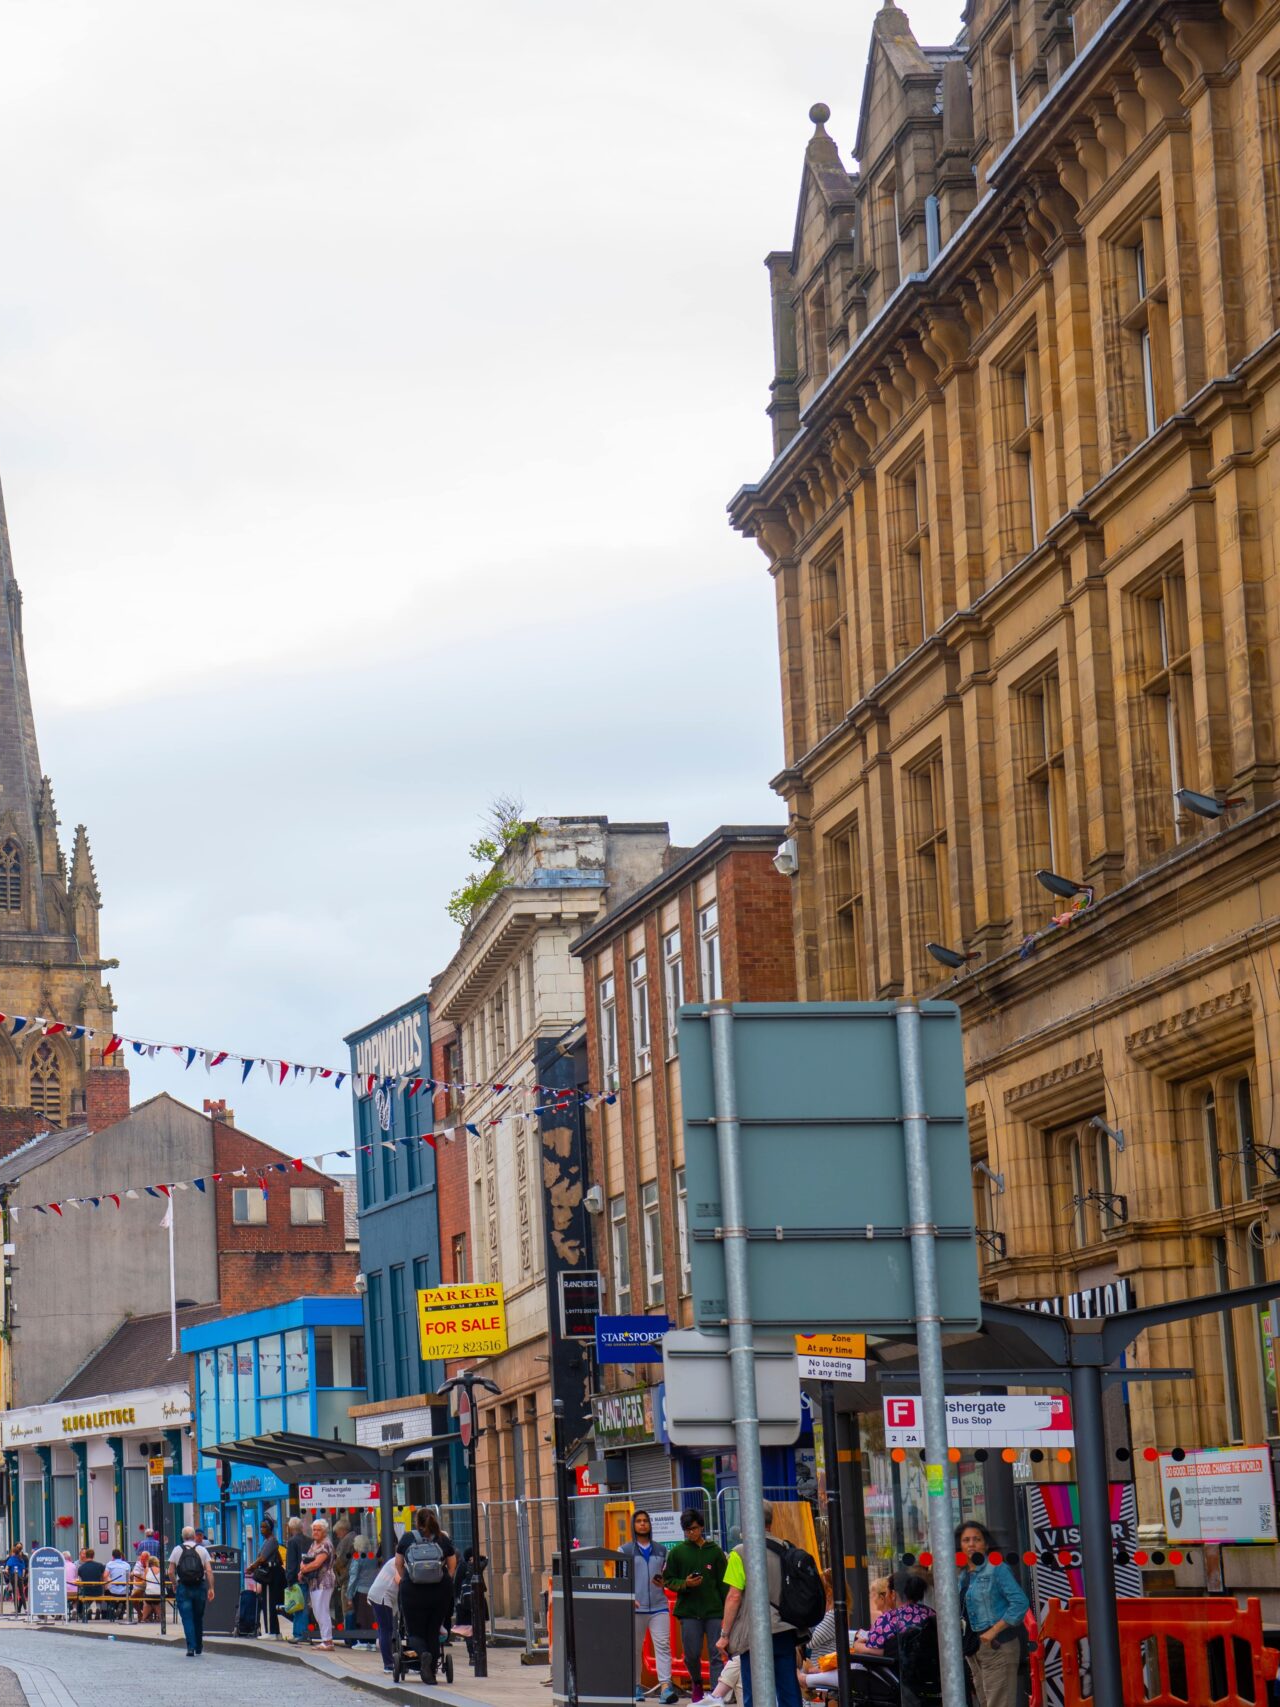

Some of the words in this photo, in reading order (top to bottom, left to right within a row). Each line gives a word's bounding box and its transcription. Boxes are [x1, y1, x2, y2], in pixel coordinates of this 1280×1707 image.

[356, 1011, 422, 1095] HOPWOODS
[424, 1288, 496, 1303] PARKER
[442, 1301, 496, 1310] COMPANY
[426, 1321, 456, 1335] FOR
[462, 1317, 500, 1332] SALE
[428, 1344, 459, 1356] 01772
[463, 1340, 501, 1353] 823516
[819, 1346, 832, 1354] any
[823, 1360, 851, 1370] loading
[598, 1394, 643, 1432] RANCHERS
[893, 1402, 908, 1423] F
[945, 1401, 1006, 1417] ishergate
[62, 1413, 85, 1432] SLUG
[86, 1414, 92, 1428] &
[93, 1408, 136, 1427] LETTUCE
[972, 1417, 992, 1426] Stop
[1166, 1467, 1172, 1477] DO
[1212, 1463, 1231, 1474] CHANGE
[1232, 1462, 1240, 1472] THE
[1241, 1461, 1261, 1472] WORLD.
[302, 1488, 311, 1498] G
[39, 1578, 58, 1586] NOW
